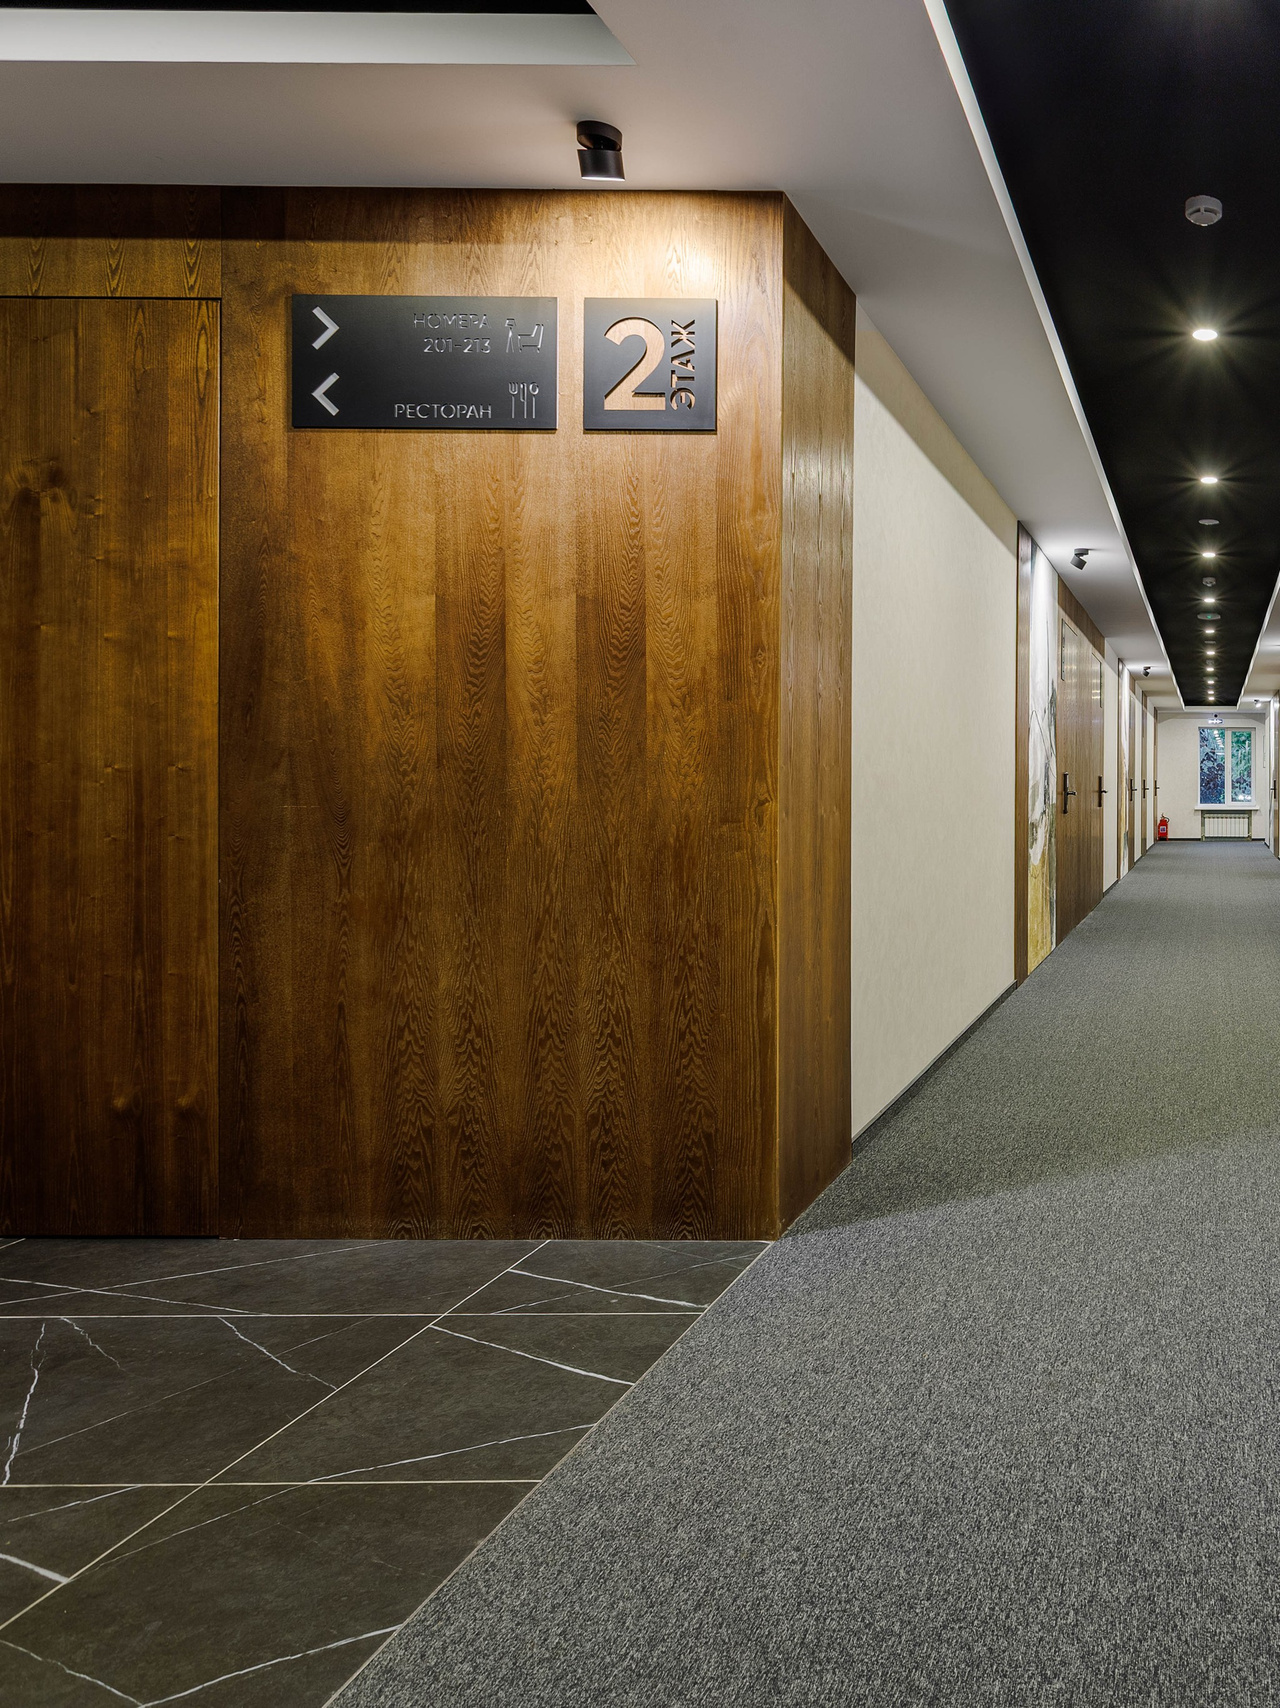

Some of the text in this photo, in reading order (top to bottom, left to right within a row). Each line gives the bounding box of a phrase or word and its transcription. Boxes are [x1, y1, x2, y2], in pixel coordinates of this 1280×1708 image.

[414, 312, 491, 329] НОМЕРА
[423, 336, 491, 354] 201-213
[603, 316, 666, 410] 2
[670, 319, 696, 411] ЭТАЖ
[394, 402, 492, 420] РЕСТОРАН
